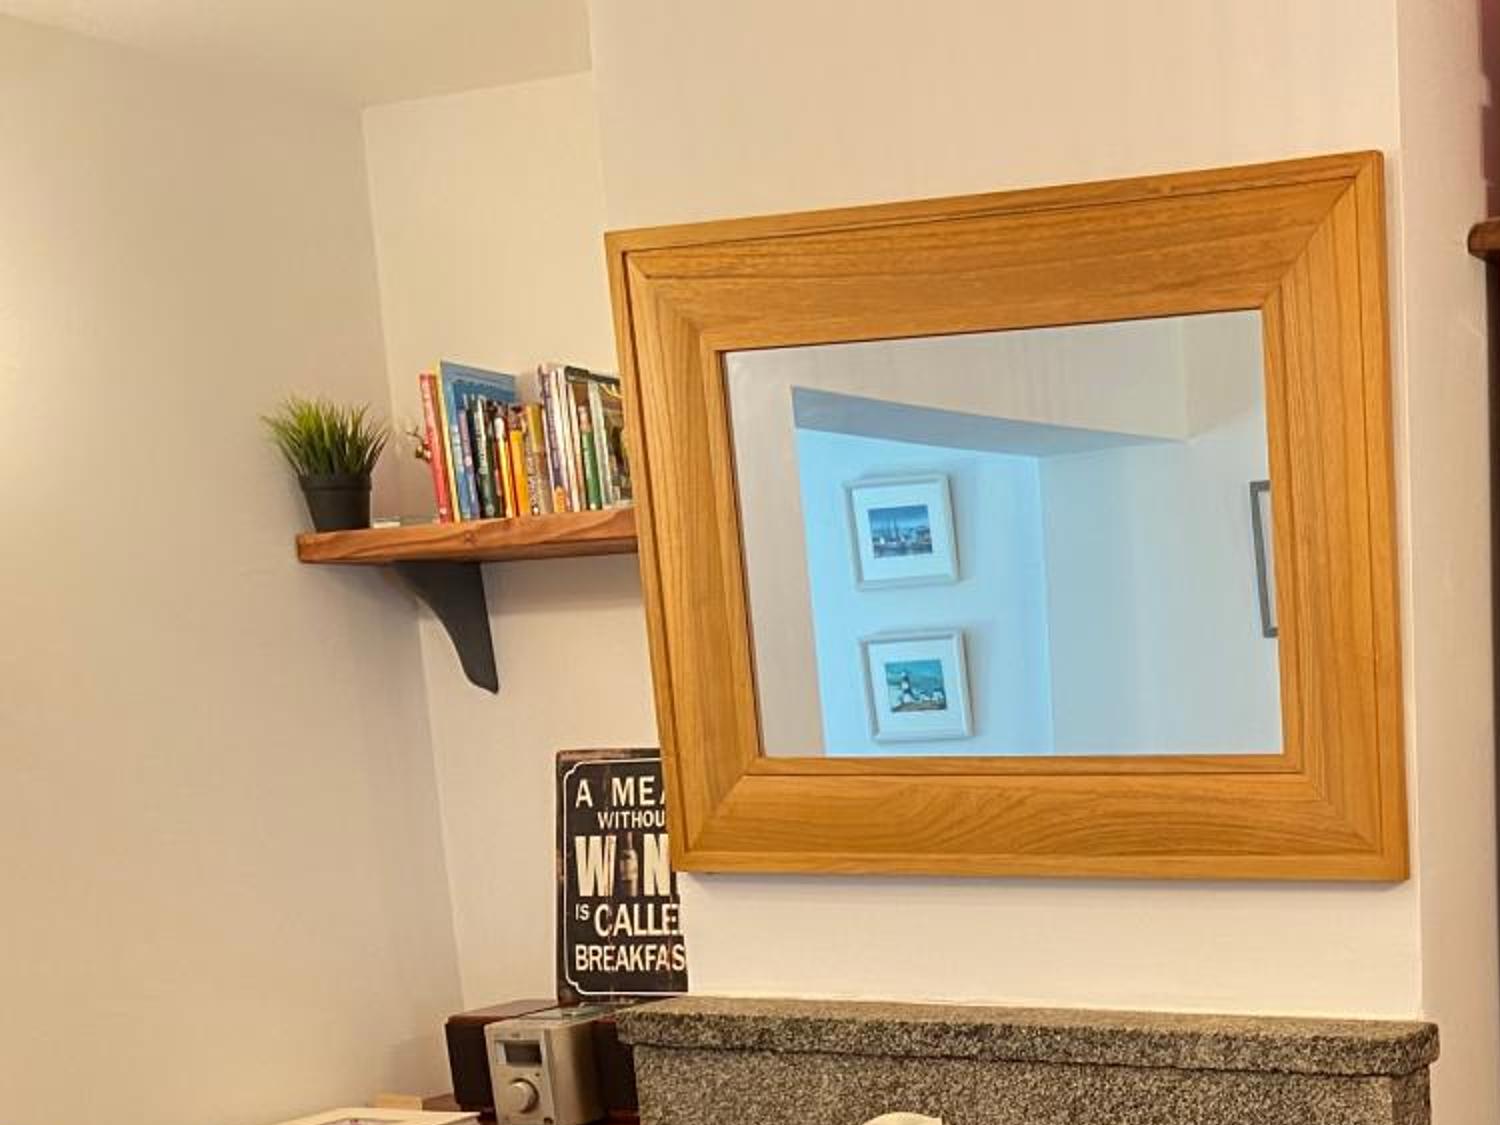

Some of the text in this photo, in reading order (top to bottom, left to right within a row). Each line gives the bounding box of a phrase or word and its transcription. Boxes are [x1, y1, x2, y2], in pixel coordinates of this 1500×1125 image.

[575, 775, 667, 809] A ME
[575, 903, 685, 938] IS CALLE
